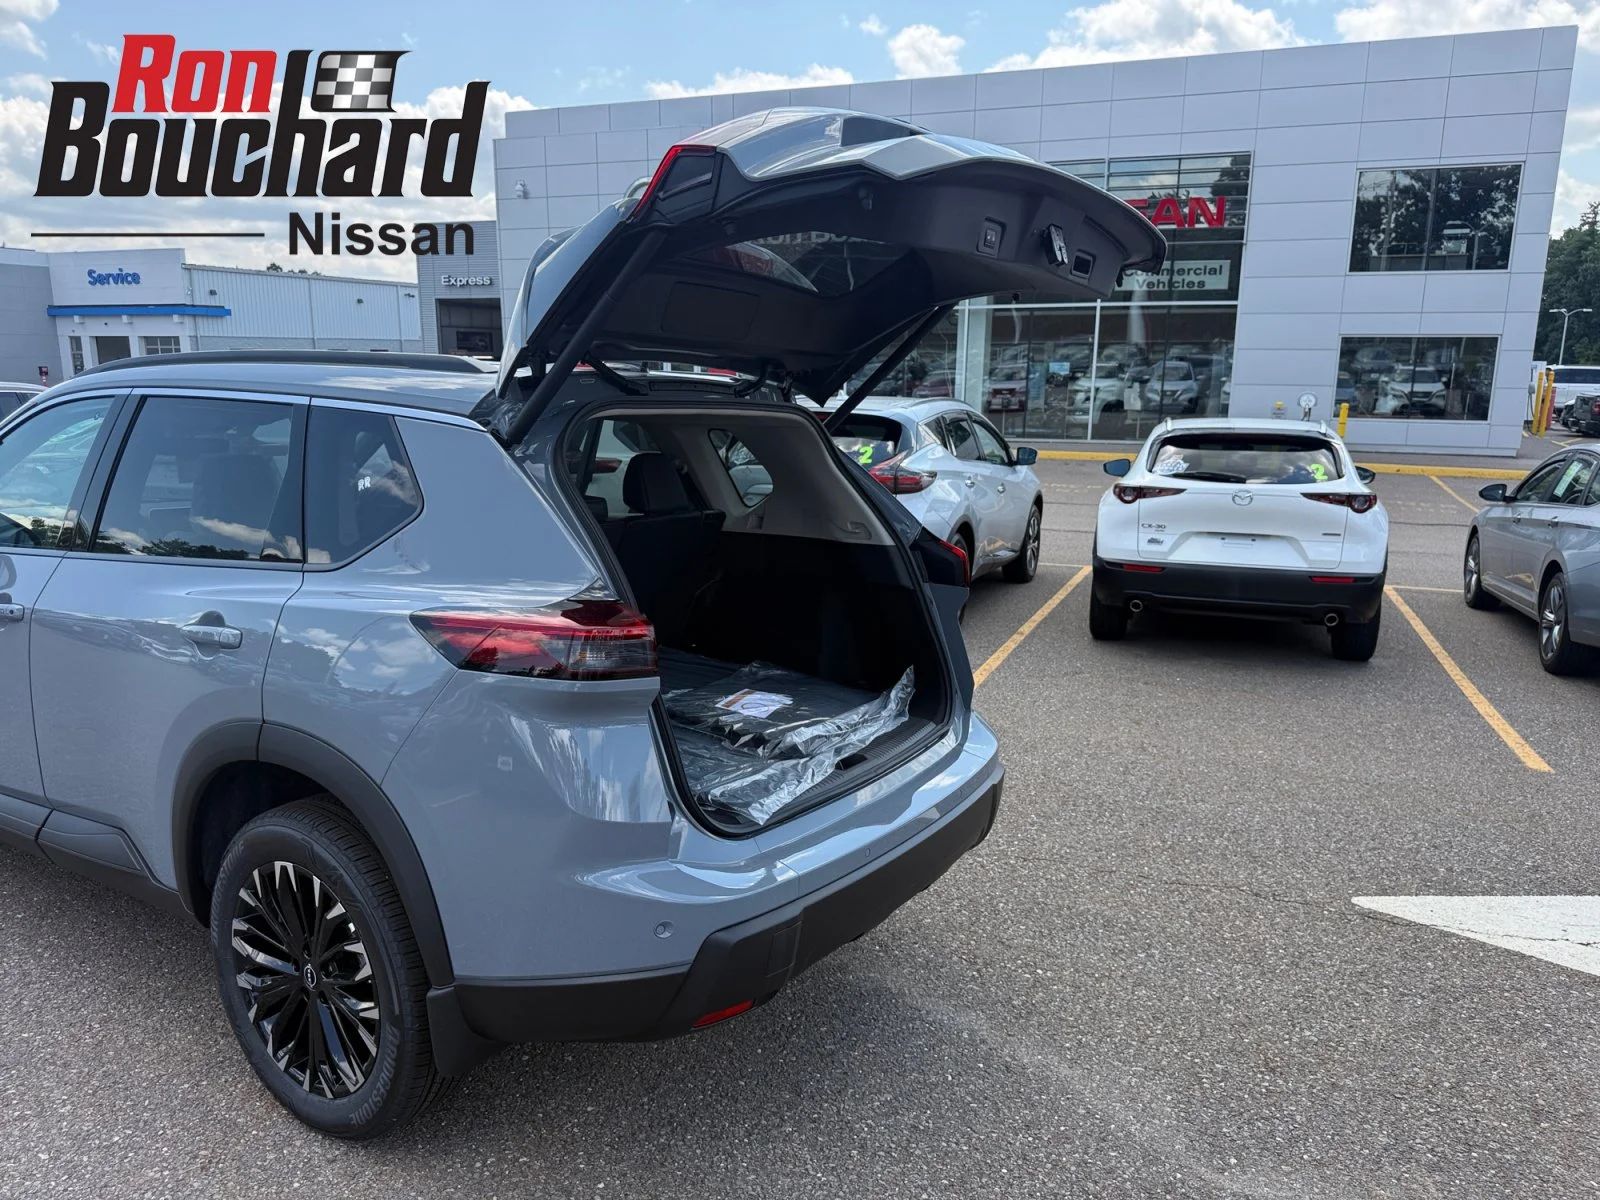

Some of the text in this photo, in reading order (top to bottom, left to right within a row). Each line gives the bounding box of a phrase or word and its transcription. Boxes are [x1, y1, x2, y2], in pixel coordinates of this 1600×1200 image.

[87, 267, 141, 286] Service
[441, 274, 491, 288] Express
[859, 446, 873, 464] 2
[1310, 463, 1328, 480] 2
